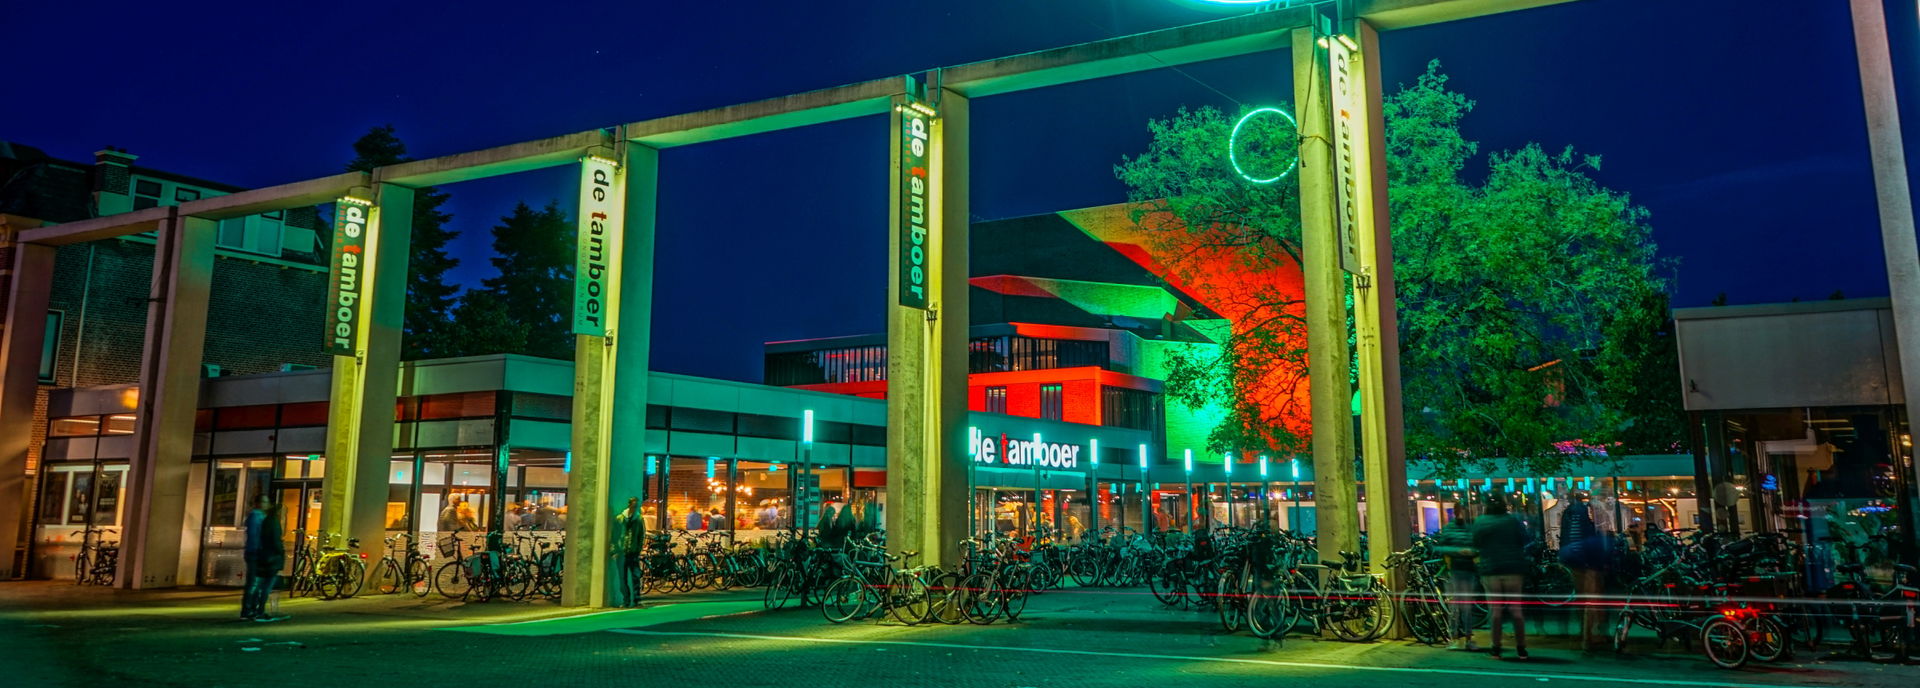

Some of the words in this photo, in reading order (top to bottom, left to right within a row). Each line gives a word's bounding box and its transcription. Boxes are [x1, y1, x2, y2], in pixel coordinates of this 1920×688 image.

[1337, 53, 1348, 95] de
[911, 118, 928, 157] de
[593, 169, 609, 202] de
[1340, 108, 1358, 263] tamboer
[345, 207, 365, 238] de
[911, 166, 927, 300] tamboer
[586, 211, 608, 327] tamboer
[335, 244, 362, 349] tamboer
[1001, 433, 1080, 468] tamboer
